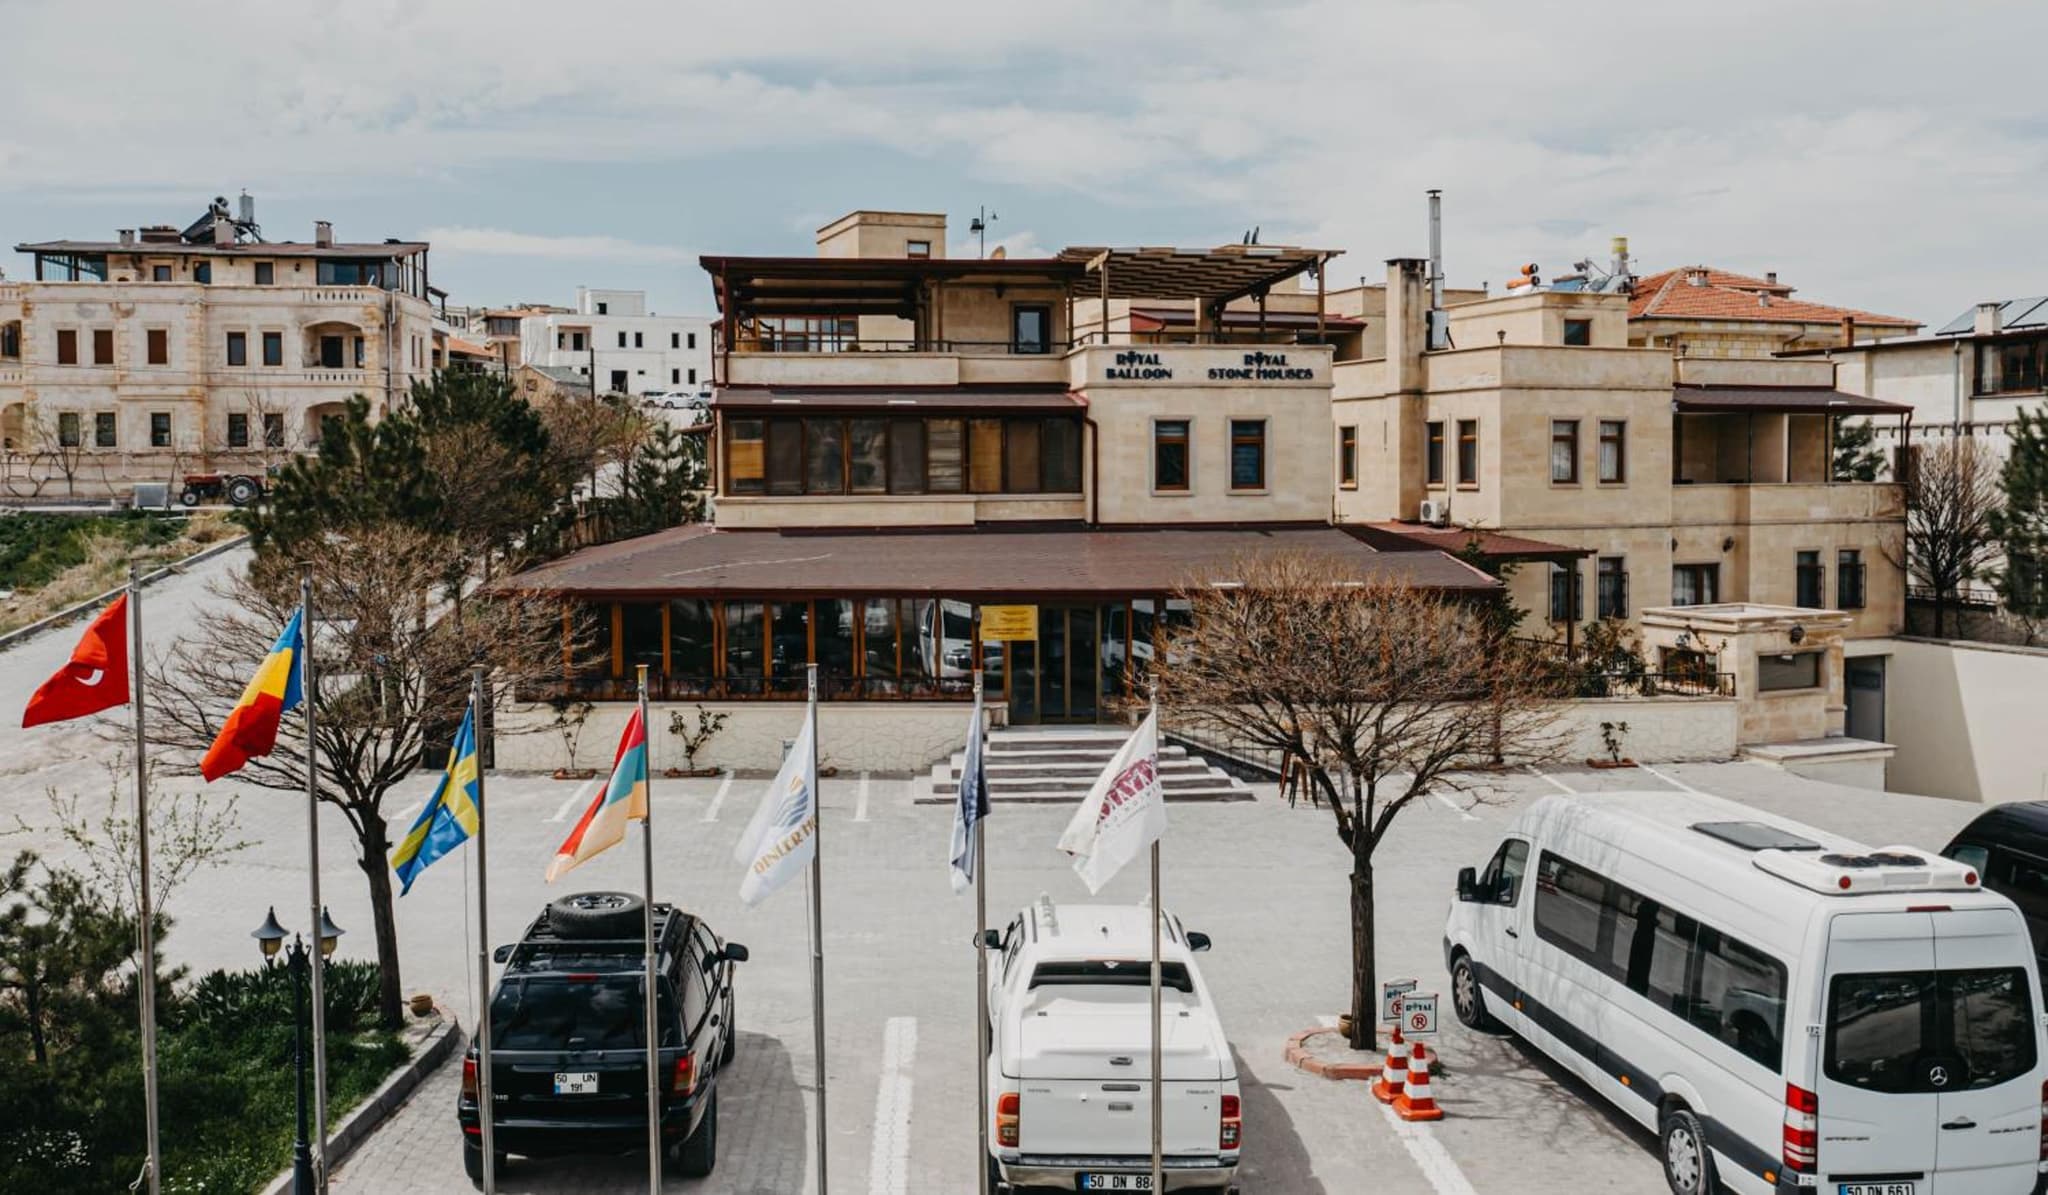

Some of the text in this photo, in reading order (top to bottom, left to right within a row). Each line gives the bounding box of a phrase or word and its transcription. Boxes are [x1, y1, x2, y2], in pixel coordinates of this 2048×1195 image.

[1116, 351, 1162, 368] ROYAL
[1244, 352, 1289, 368] ROYAL
[1106, 368, 1172, 380] BALLOON
[1208, 368, 1313, 380] STONE HOUSES
[556, 1074, 568, 1084] 50
[1090, 1175, 1153, 1189] 50 DN 88
[1847, 1186, 1863, 1195] 50
[1888, 1185, 1910, 1195] 661
